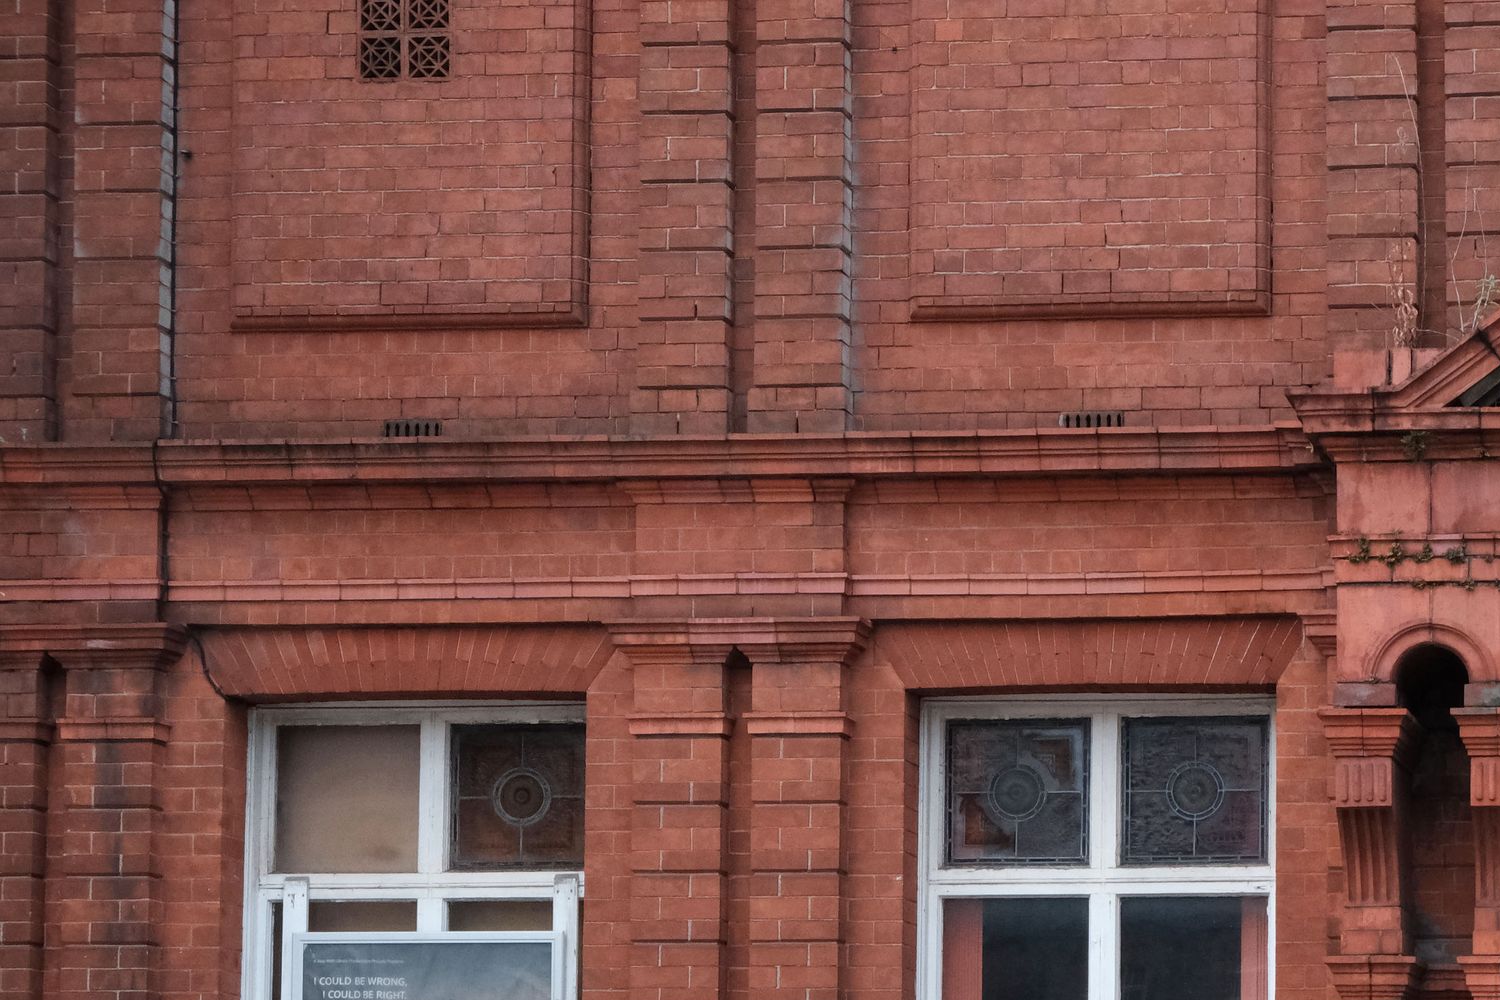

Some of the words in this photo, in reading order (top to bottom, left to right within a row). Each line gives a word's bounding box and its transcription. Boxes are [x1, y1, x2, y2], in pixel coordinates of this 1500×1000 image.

[318, 976, 352, 986] COULD
[354, 976, 366, 986] BE
[367, 976, 408, 988] WRONG,
[327, 989, 361, 999] COULD
[362, 990, 374, 999] BE
